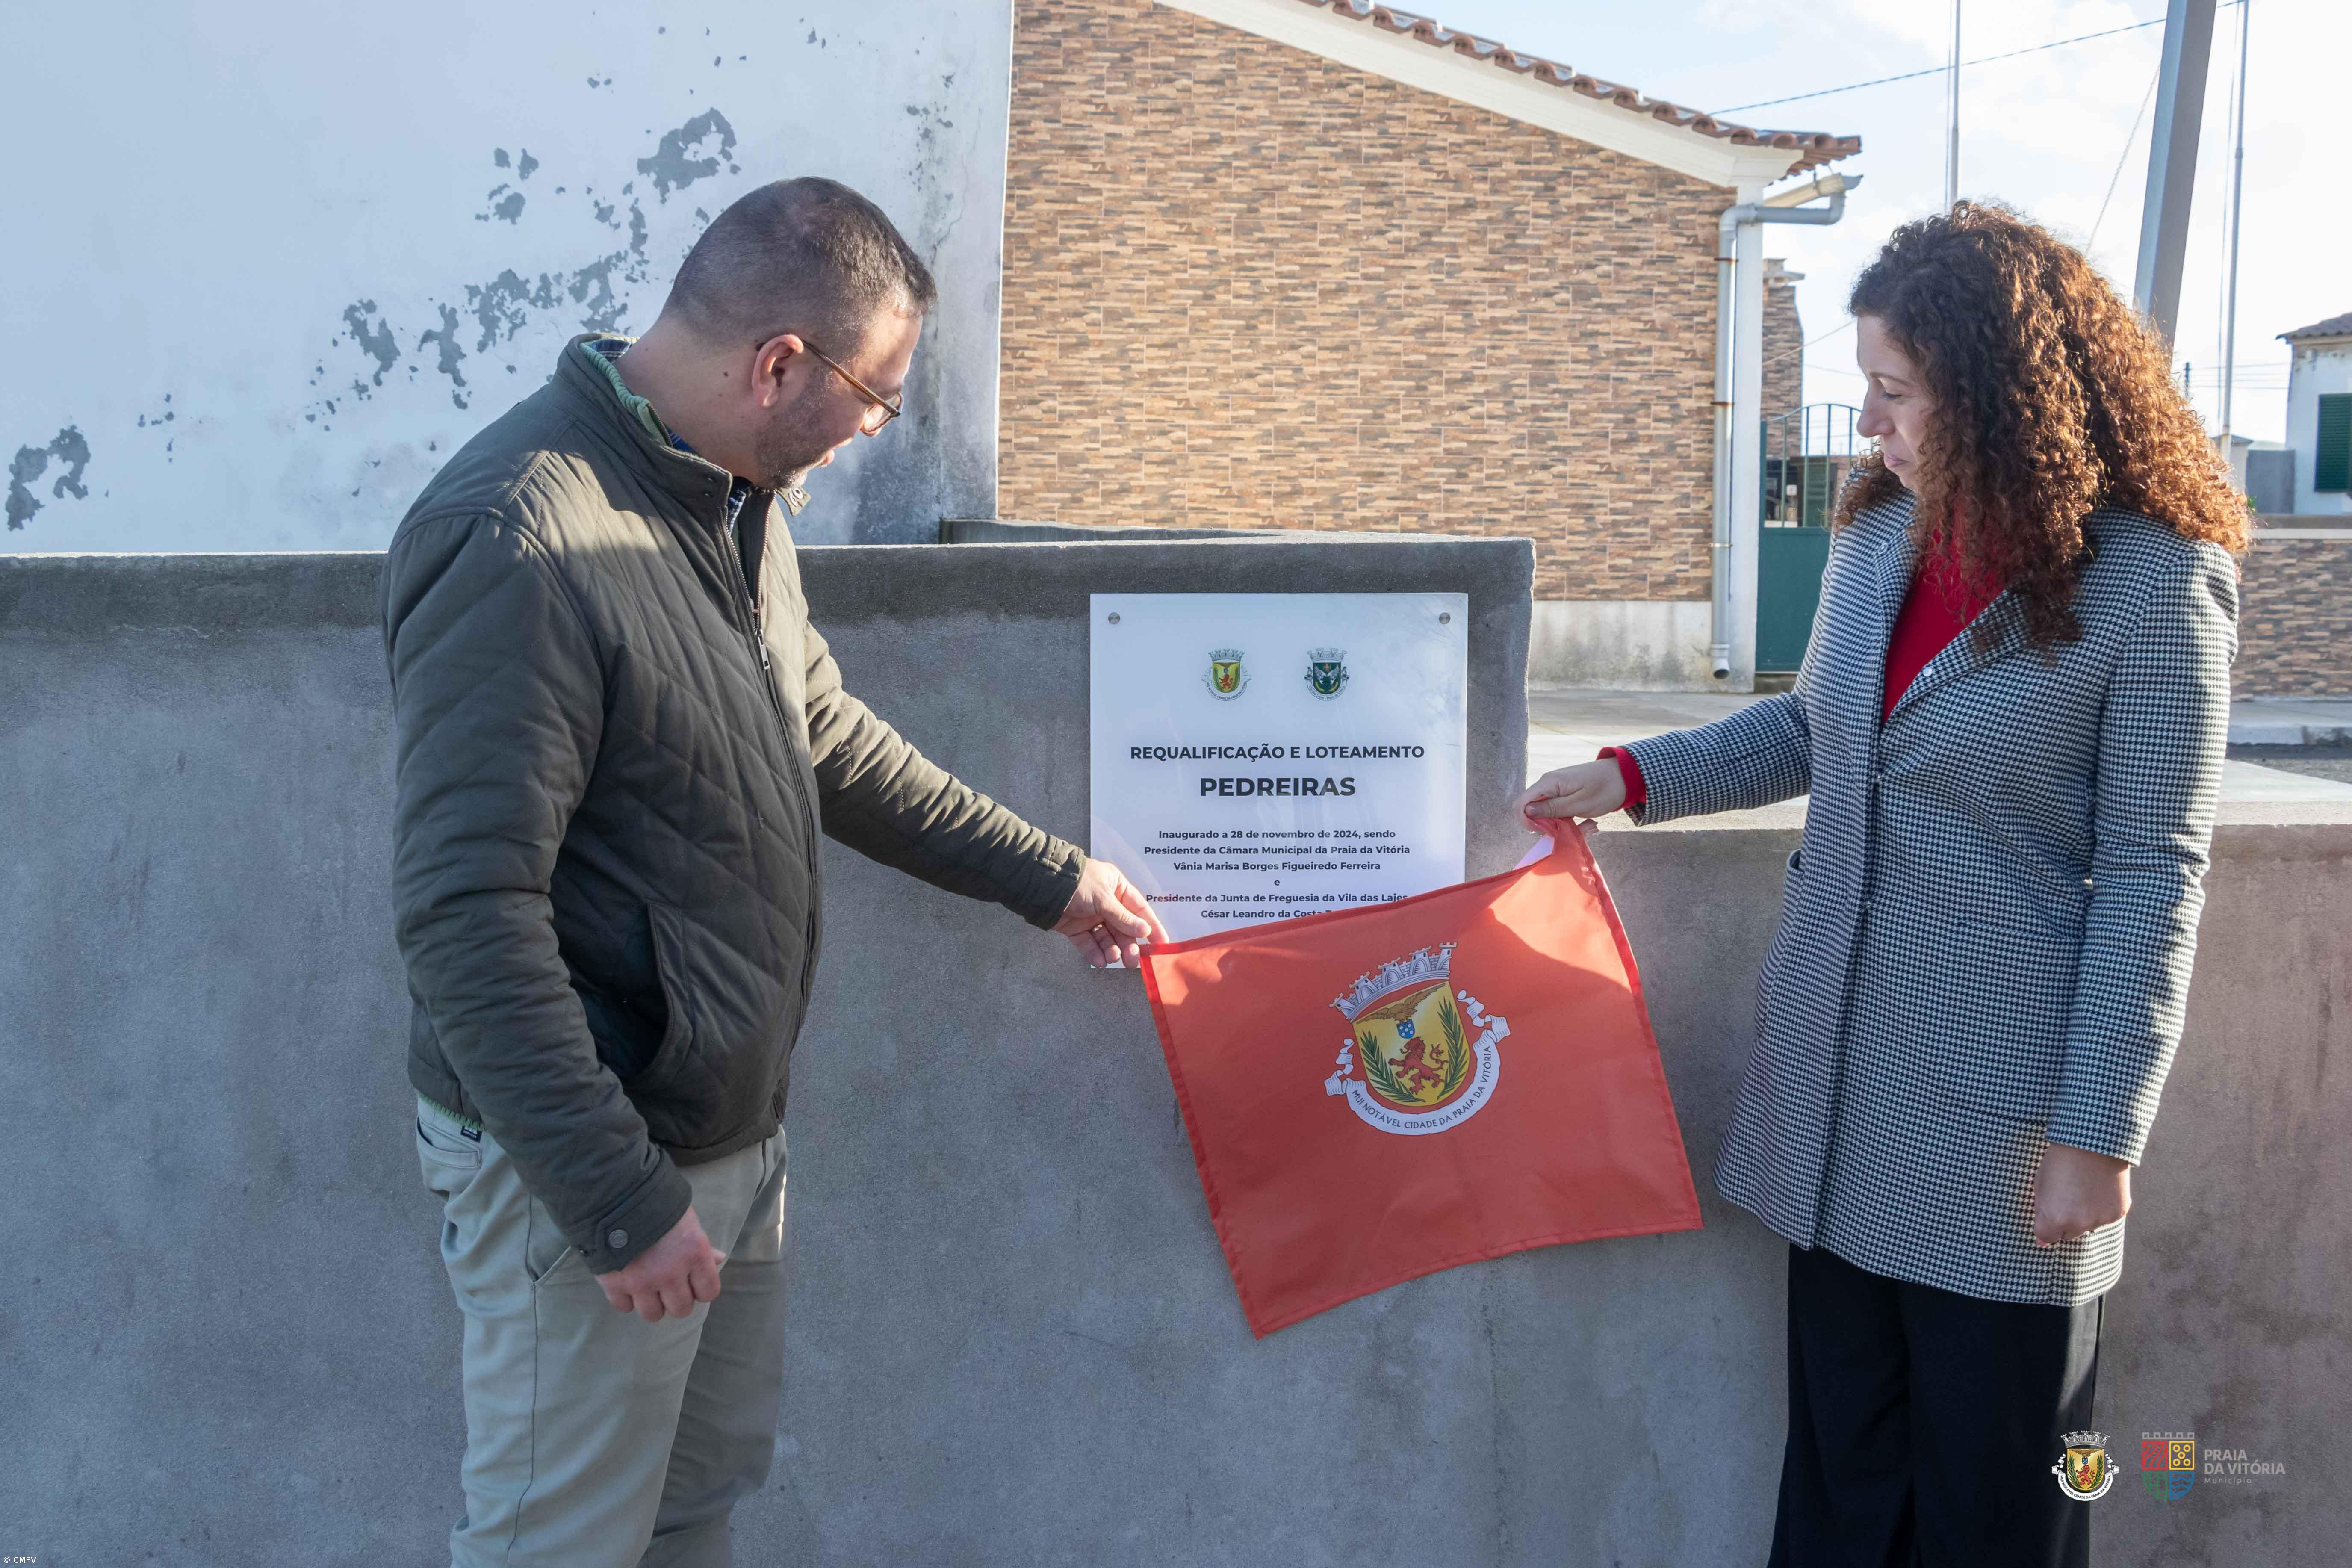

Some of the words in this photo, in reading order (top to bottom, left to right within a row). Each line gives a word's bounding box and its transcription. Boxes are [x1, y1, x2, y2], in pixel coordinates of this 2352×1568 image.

[1130, 743, 1284, 762] REQUALIFICAÇÃO
[1291, 747, 1300, 759] E
[1306, 746, 1425, 759] LOTEAMENTO
[1200, 777, 1356, 797] PEDREIRAS
[1159, 830, 1219, 840] Inaugurado
[1246, 830, 1259, 838] de
[1262, 830, 1315, 838] novembro
[1318, 830, 1331, 838] de
[1333, 830, 1361, 839] 2024,
[1364, 830, 1396, 838] sendo
[1144, 846, 1200, 854] Presidente
[1203, 846, 1216, 854] da
[1219, 846, 1259, 854] Câmara
[1262, 846, 1312, 856] Municipal
[1331, 845, 1357, 854] Praia
[1360, 846, 1372, 854] da
[1375, 845, 1410, 854] Vitória
[1173, 862, 1202, 870] Vânia
[1205, 862, 1239, 870] Marisa
[1242, 862, 1279, 872] Borges
[1282, 861, 1338, 872] Figueiredo
[1341, 861, 1381, 870] Ferreira
[1269, 893, 1319, 904] Freguesia
[1338, 893, 1357, 901] Vila
[1201, 909, 1230, 918] César
[1233, 909, 1275, 918] Leandro
[1352, 1089, 1363, 1106] MUI
[1363, 1101, 1401, 1128] NOTÁVEL
[1404, 1119, 1438, 1129] CIDADE
[1438, 1115, 1453, 1126] DA
[1452, 1098, 1477, 1119] PRAIA
[1473, 1085, 1486, 1099] DA
[1480, 1046, 1492, 1083] VITÓRIA
